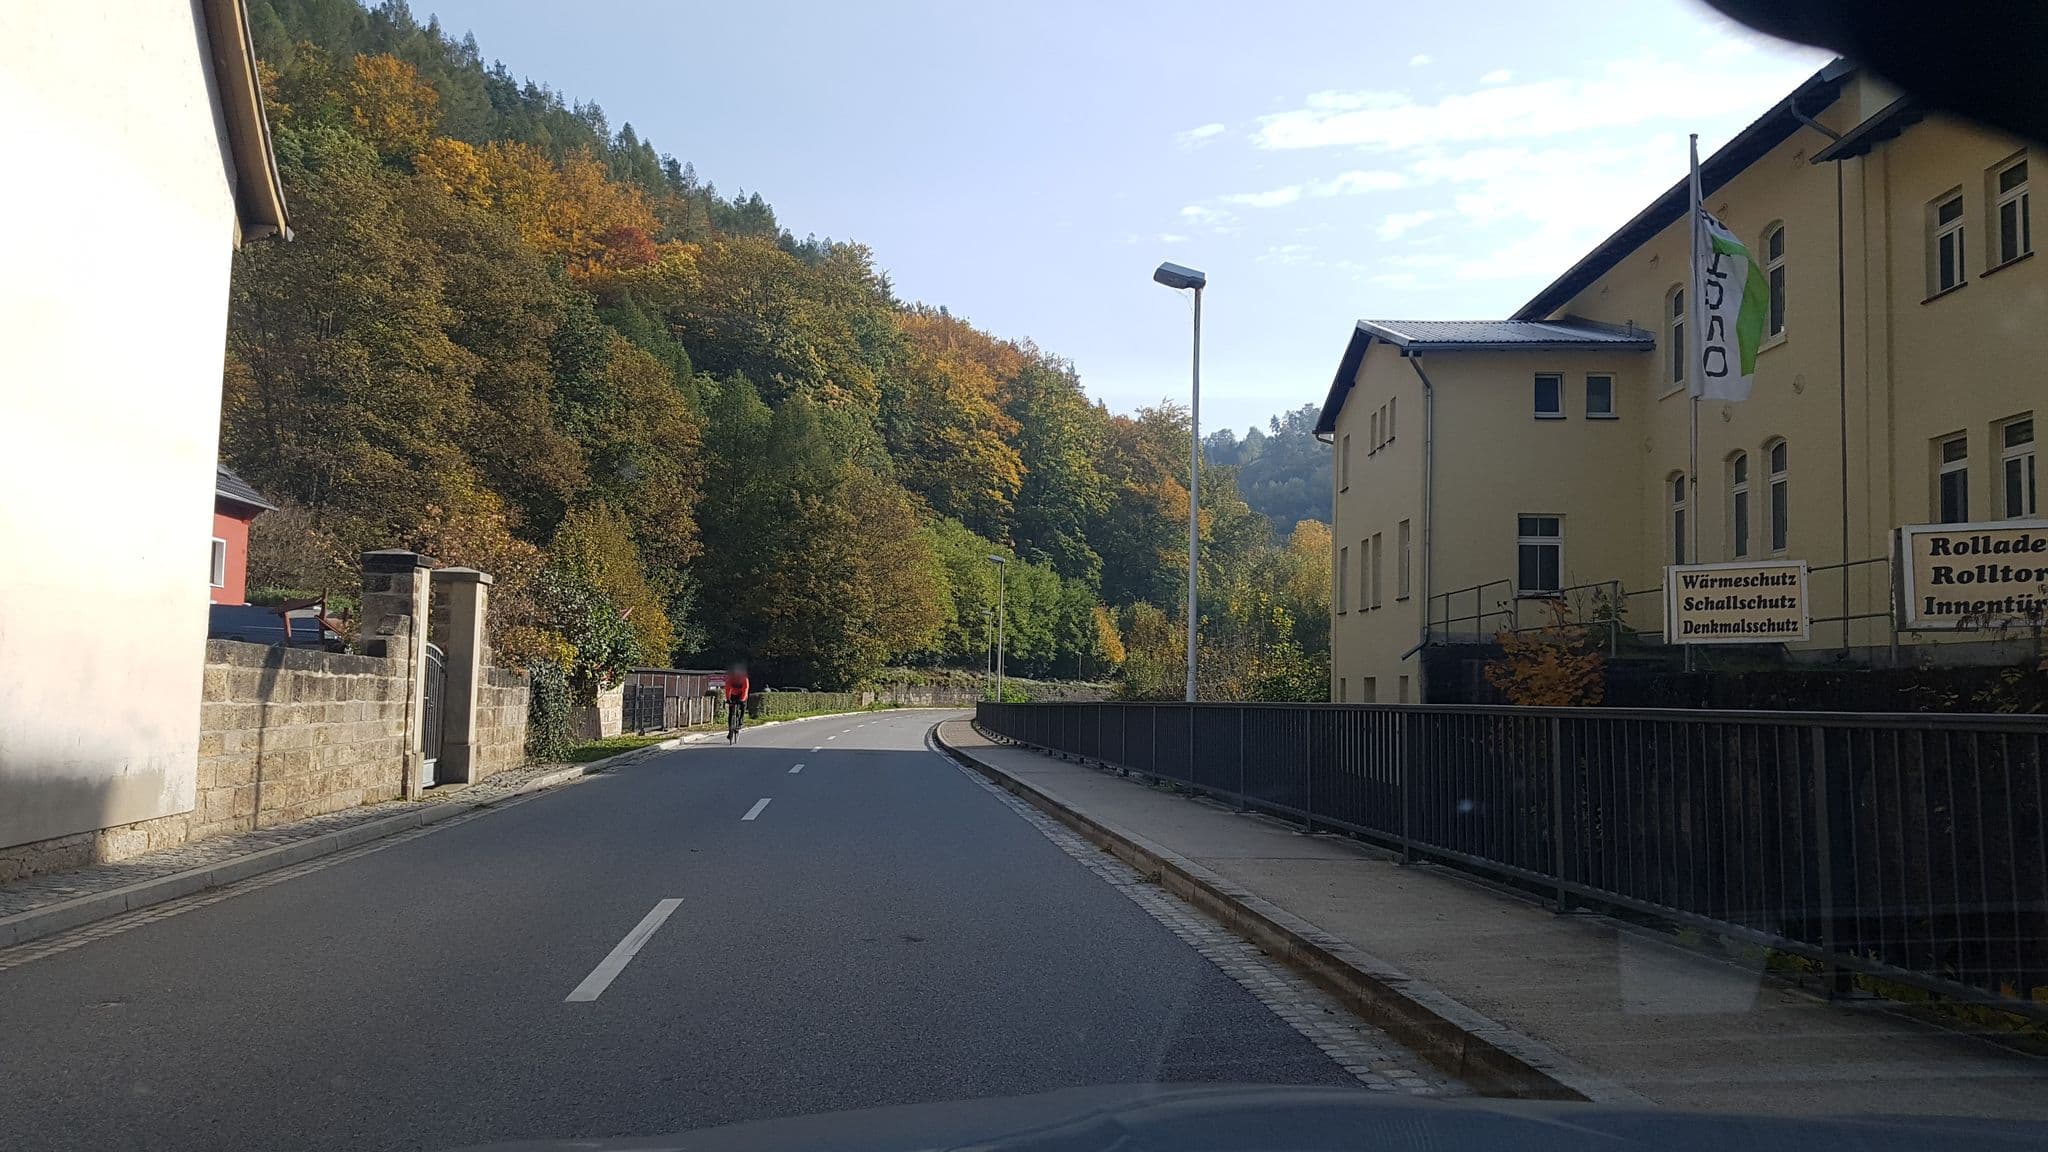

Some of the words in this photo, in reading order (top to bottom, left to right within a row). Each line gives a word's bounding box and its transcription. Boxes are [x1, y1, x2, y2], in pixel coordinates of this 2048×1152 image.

[1929, 534, 2048, 556] Rollade
[1682, 572, 1797, 589] Wärmeschutz
[1931, 564, 2048, 585] Rolltor
[1683, 594, 1796, 611] Schallschutz
[1683, 617, 1799, 634] Denkmalsschutz
